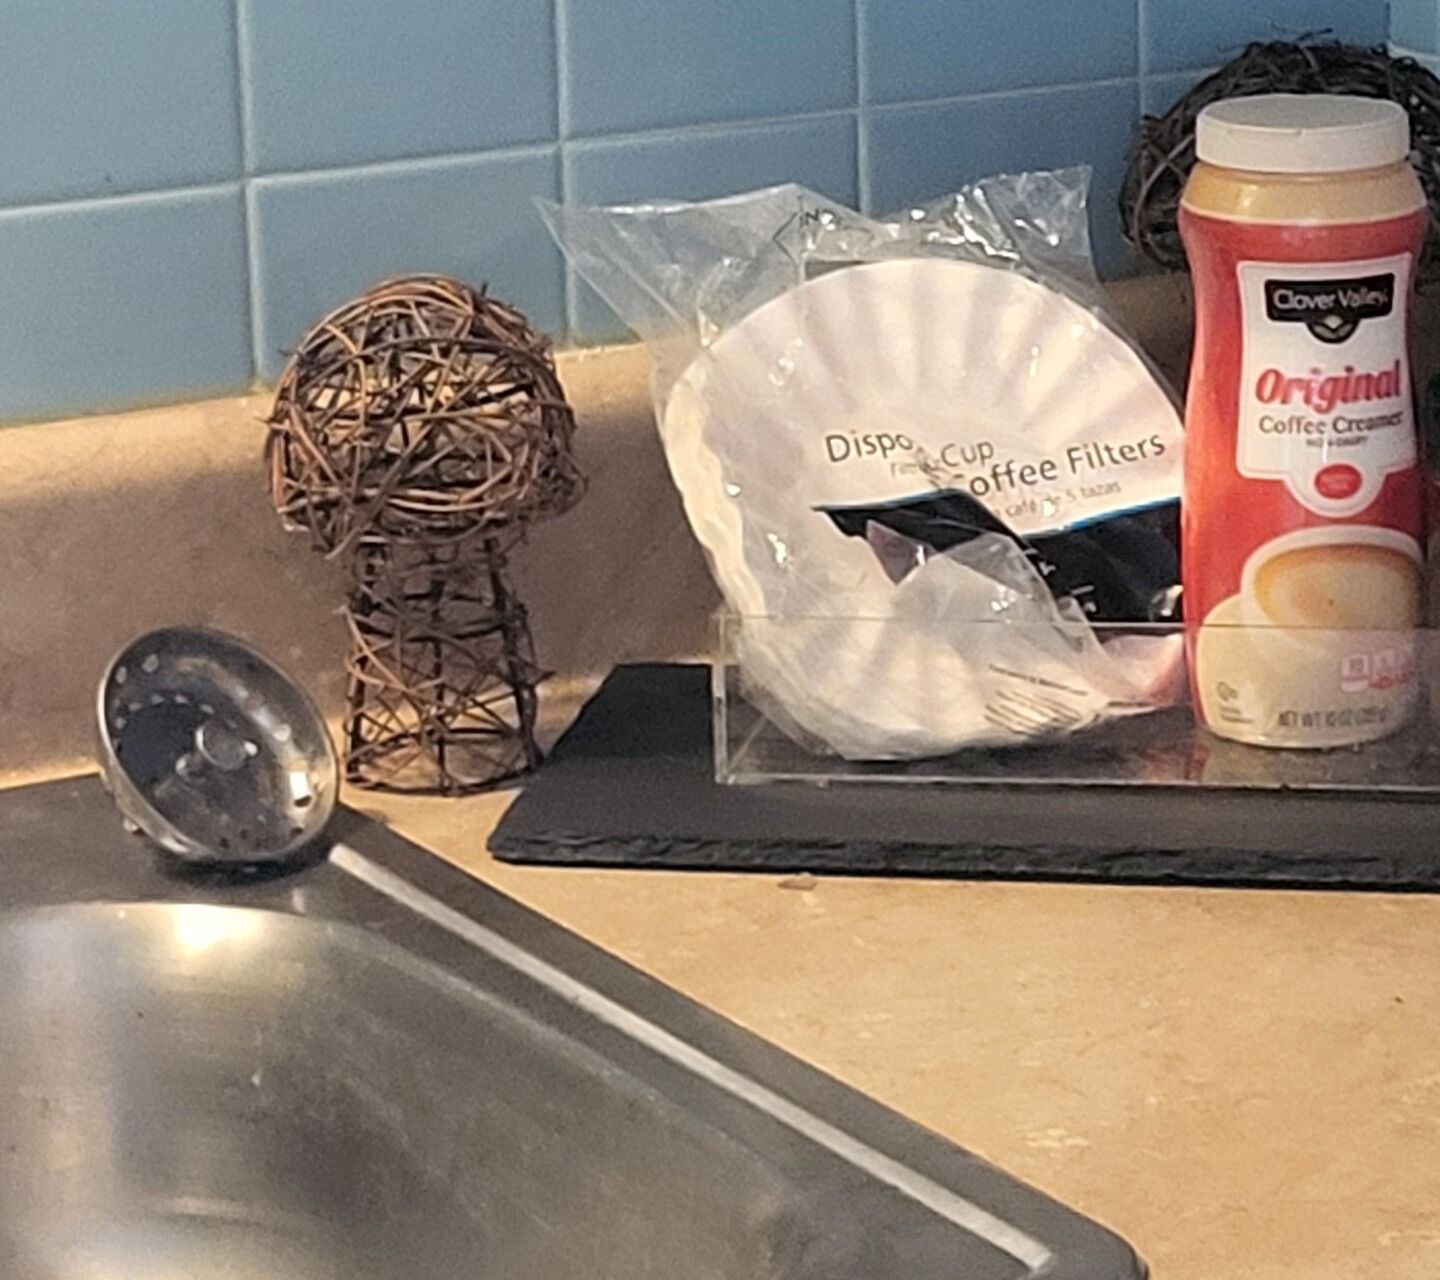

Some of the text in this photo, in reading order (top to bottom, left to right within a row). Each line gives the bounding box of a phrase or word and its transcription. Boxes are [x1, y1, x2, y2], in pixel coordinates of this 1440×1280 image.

[1273, 288, 1336, 311] Clover
[1255, 360, 1401, 414] Original
[1258, 415, 1327, 434] Coffee
[941, 440, 994, 467] Cup
[954, 459, 1059, 496] offee
[1066, 434, 1166, 474] Filters
